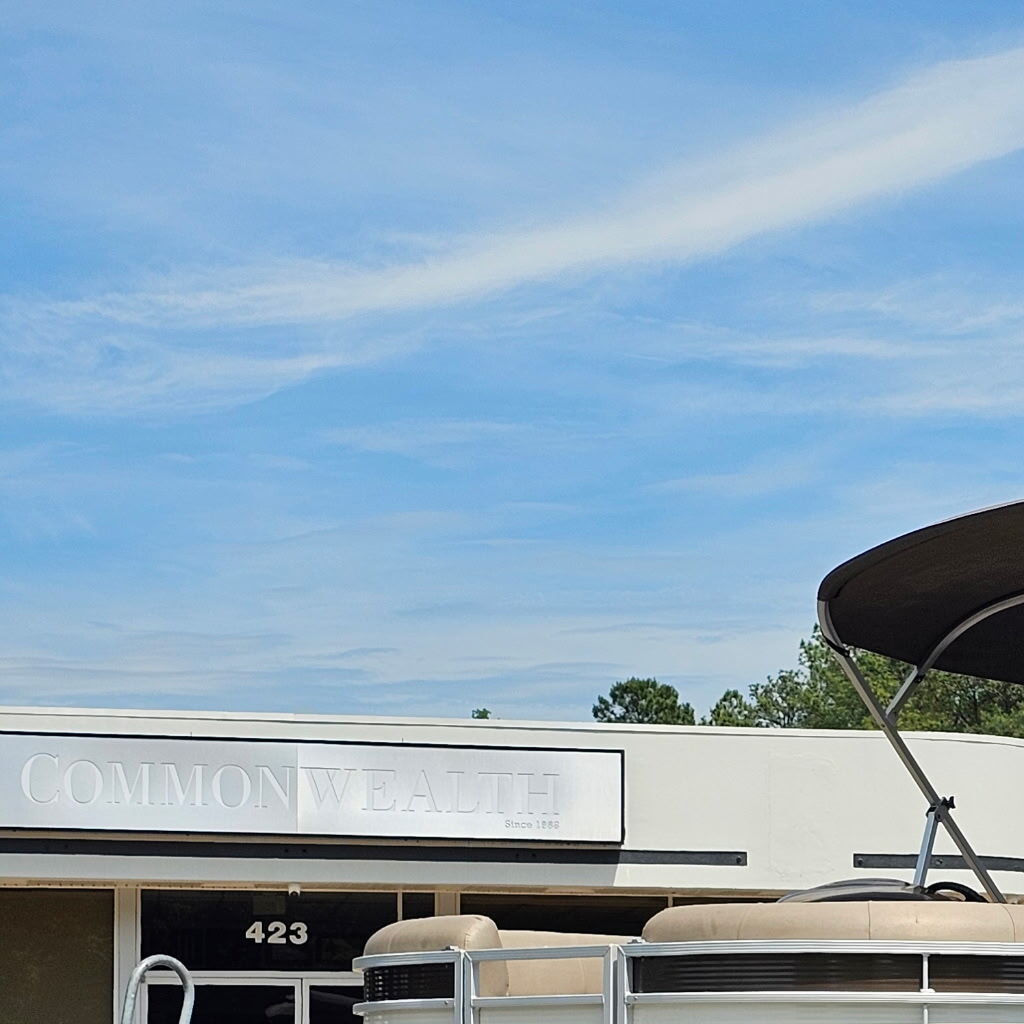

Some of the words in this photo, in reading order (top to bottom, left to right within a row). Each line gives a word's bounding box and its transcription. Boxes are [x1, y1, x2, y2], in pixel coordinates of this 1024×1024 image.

[20, 752, 560, 815] COMMONWEALTH
[504, 819, 533, 829] Since
[245, 921, 308, 945] 423
